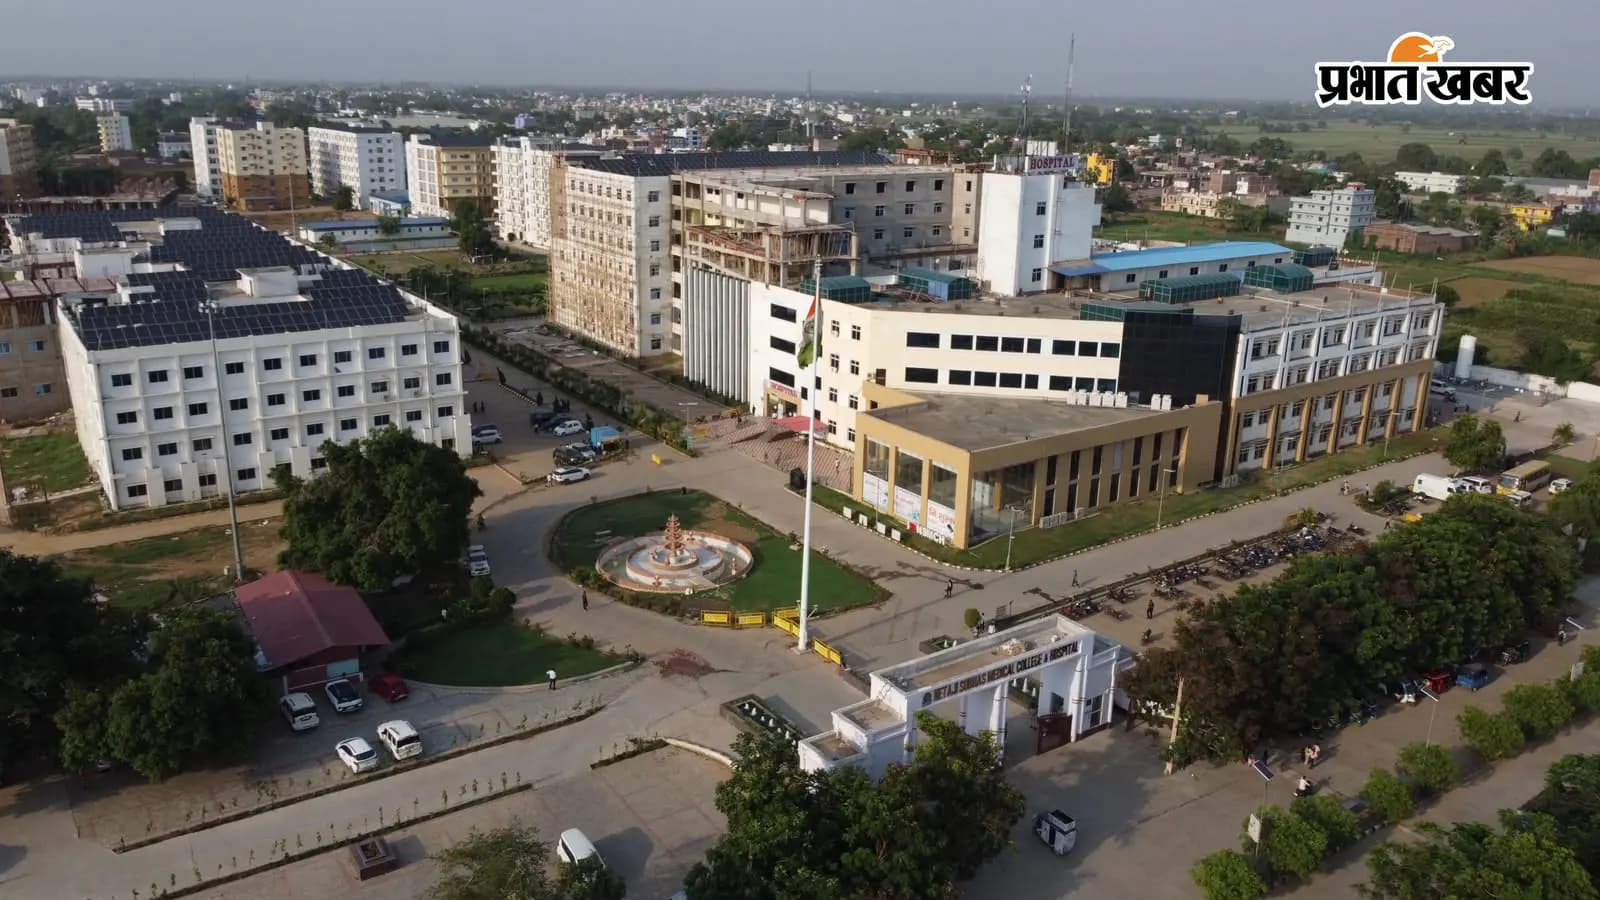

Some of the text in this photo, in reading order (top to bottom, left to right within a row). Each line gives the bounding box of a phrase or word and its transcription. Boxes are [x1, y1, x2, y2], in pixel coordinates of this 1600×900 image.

[1030, 156, 1075, 170] HOSPITAL
[933, 681, 959, 701] NETAJI
[959, 673, 987, 693] SUBHAS
[987, 665, 1017, 683] MEDICAL
[1016, 654, 1043, 672] COLLEGE
[1049, 641, 1079, 661] HOSPITAL
